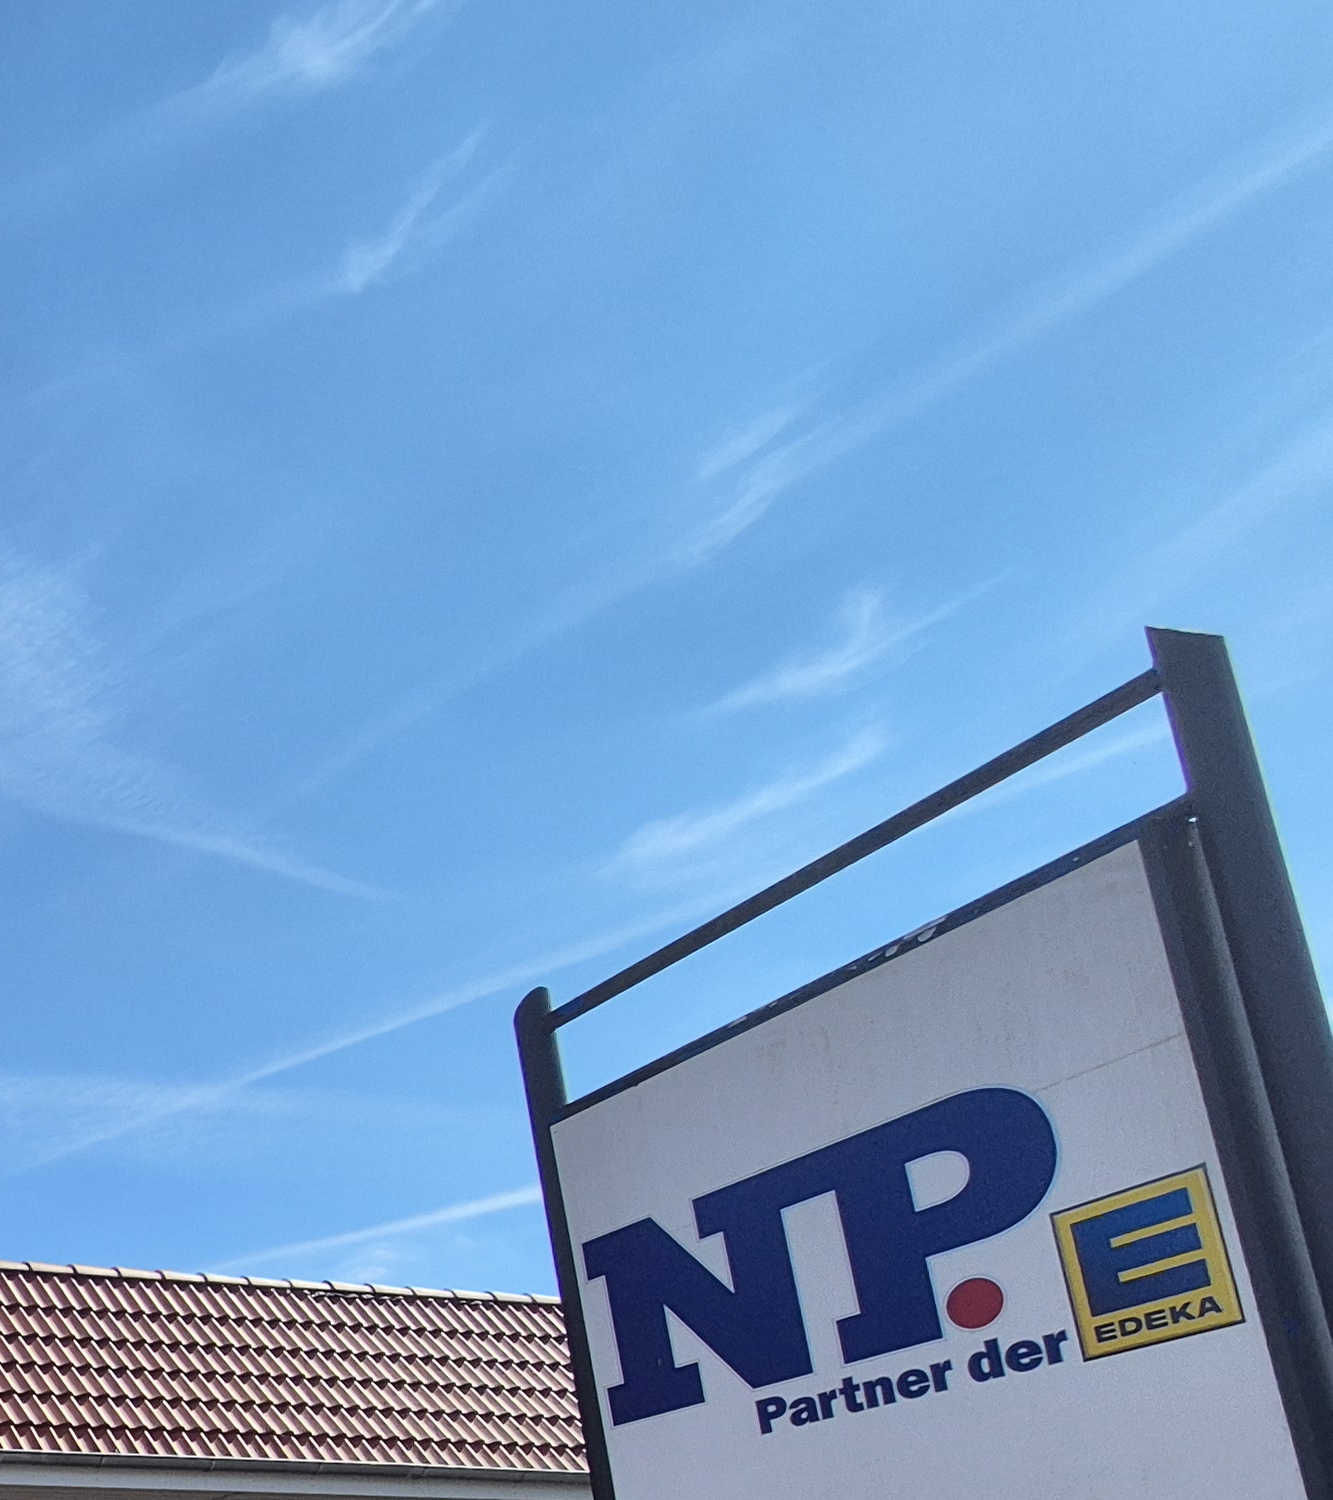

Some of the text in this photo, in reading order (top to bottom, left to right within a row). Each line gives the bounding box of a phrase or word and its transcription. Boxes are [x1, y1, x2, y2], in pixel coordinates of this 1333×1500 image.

[1094, 1295, 1224, 1344] EDEKA
[756, 1330, 1068, 1435] Partner der
